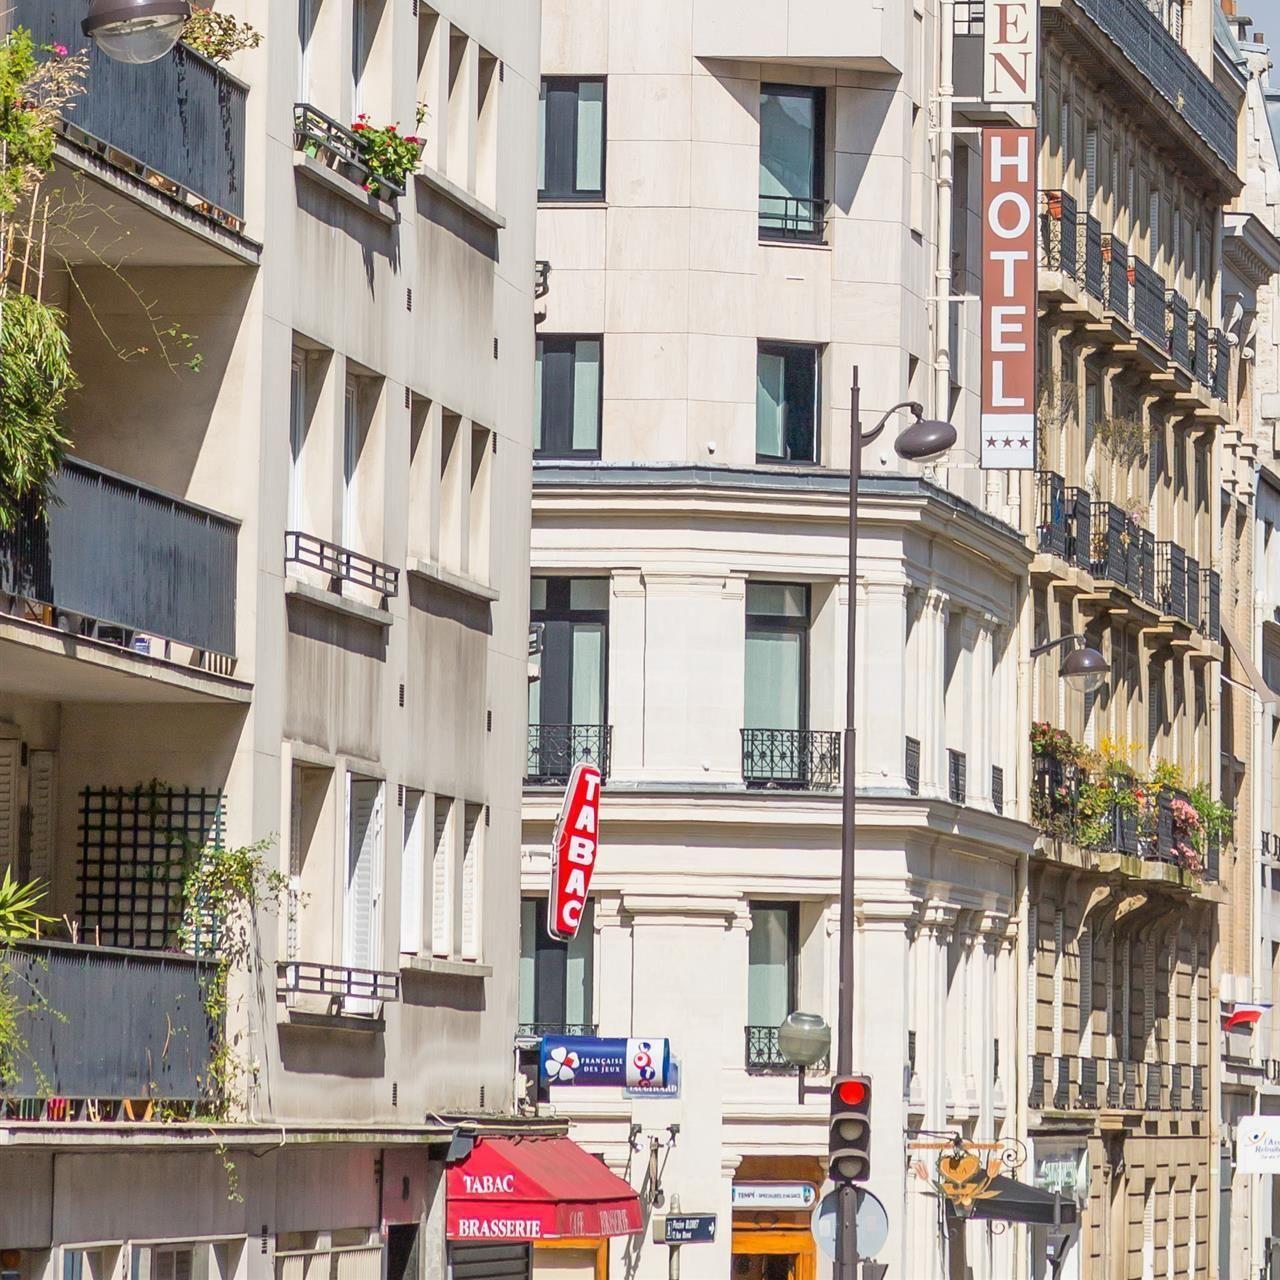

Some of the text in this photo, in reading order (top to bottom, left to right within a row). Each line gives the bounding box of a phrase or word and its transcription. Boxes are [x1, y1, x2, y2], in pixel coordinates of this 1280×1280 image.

[988, 136, 1031, 407] HOTEL
[562, 773, 600, 927] TABAC
[581, 1058, 623, 1067] FRANÇAISE
[463, 1175, 514, 1193] TABAC
[459, 1219, 540, 1238] BRASSERIE
